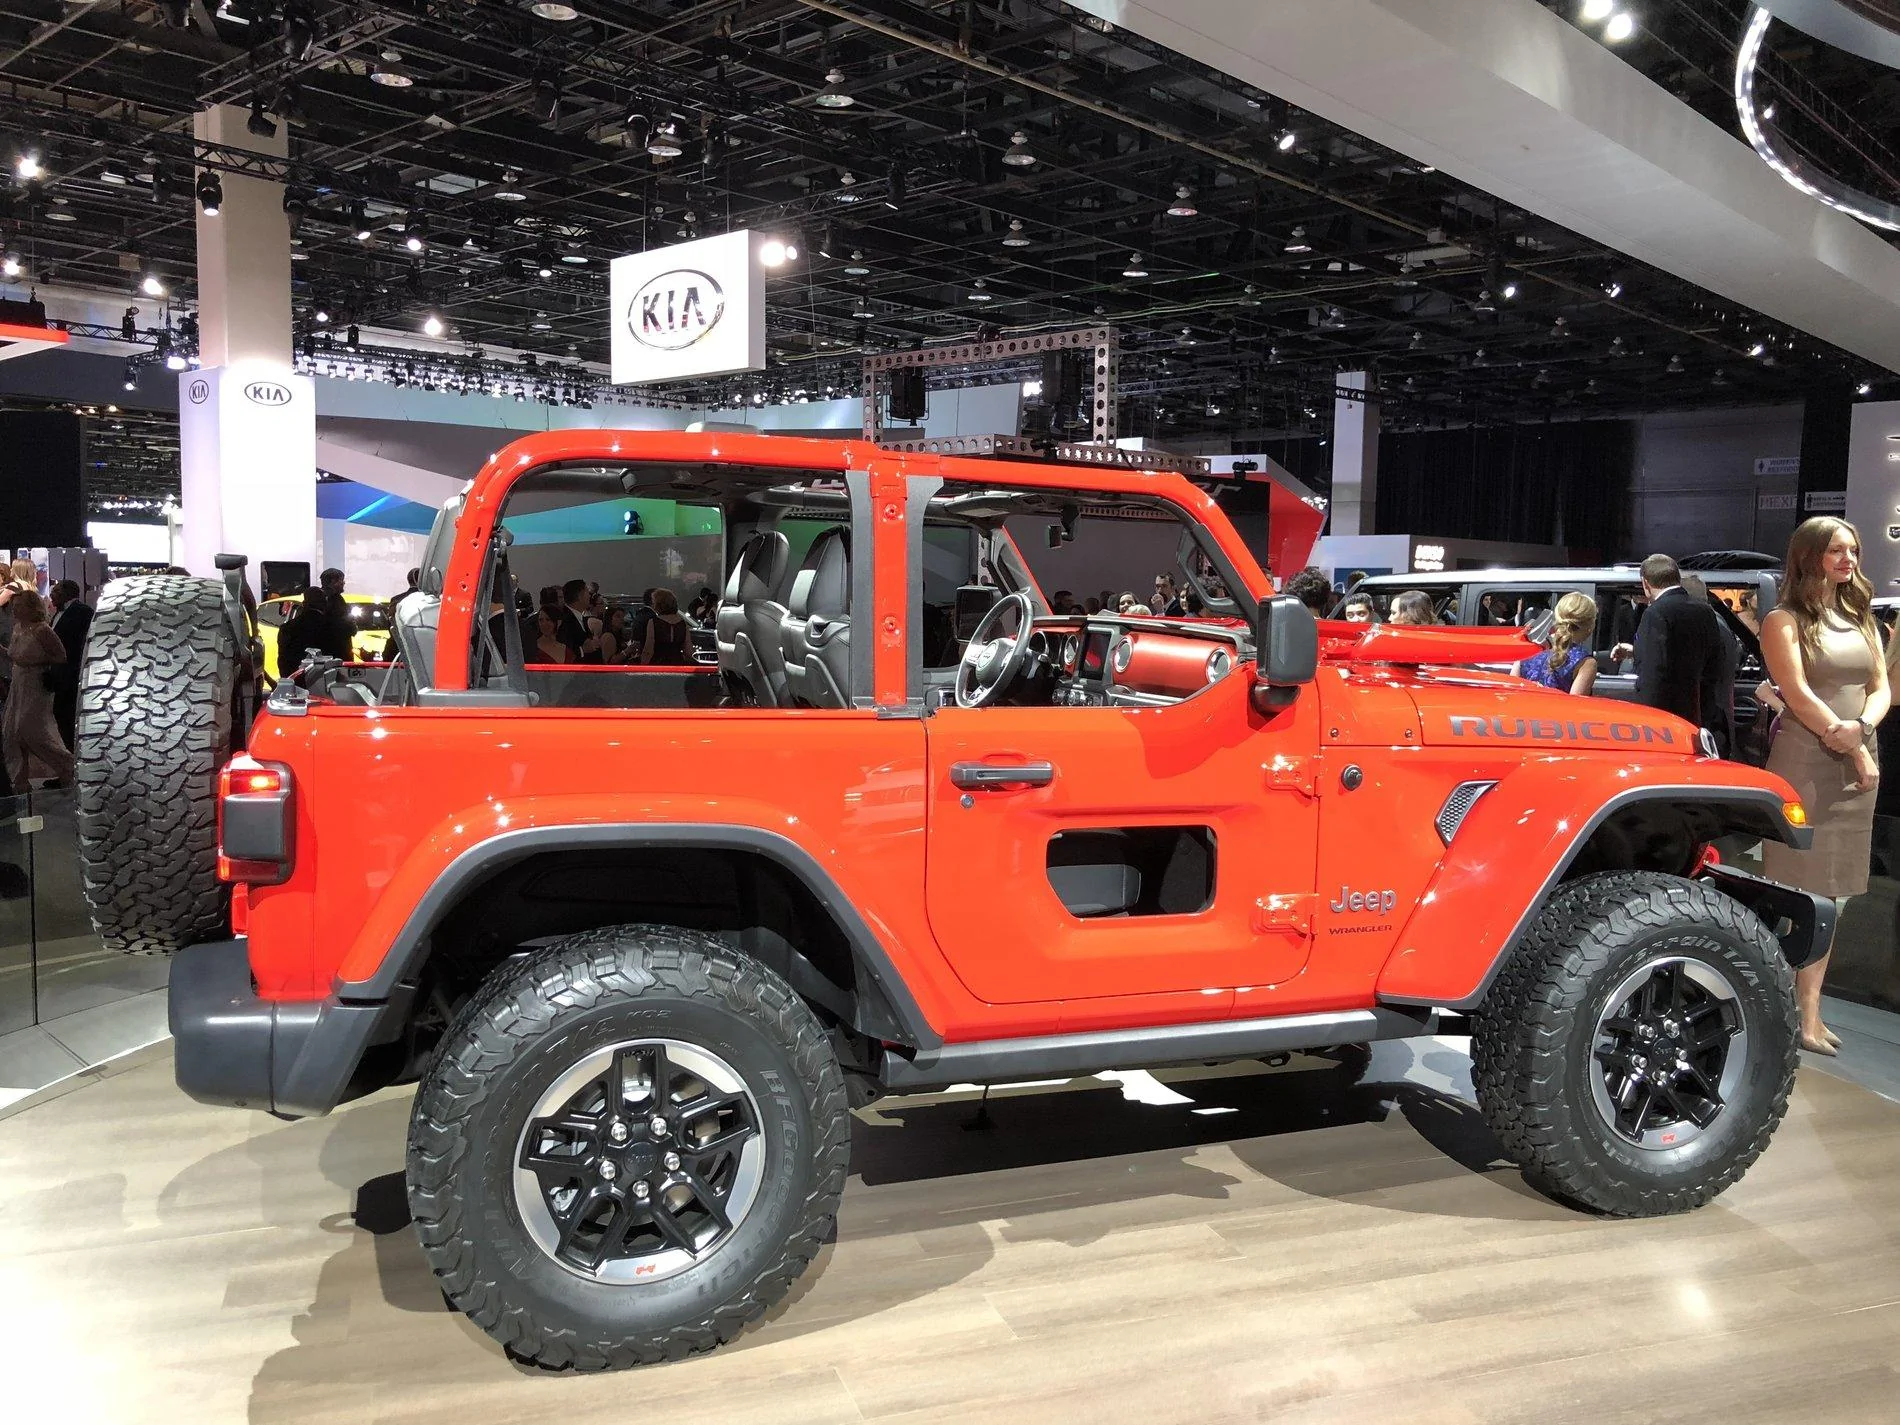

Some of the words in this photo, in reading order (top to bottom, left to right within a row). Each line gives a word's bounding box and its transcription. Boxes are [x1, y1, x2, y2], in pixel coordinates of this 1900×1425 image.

[643, 286, 706, 333] KIA
[192, 384, 206, 399] KIA
[253, 386, 284, 401] KIA
[1448, 715, 1674, 744] RUBICON
[1330, 886, 1397, 916] Jeep
[1329, 924, 1393, 935] WRANGLER
